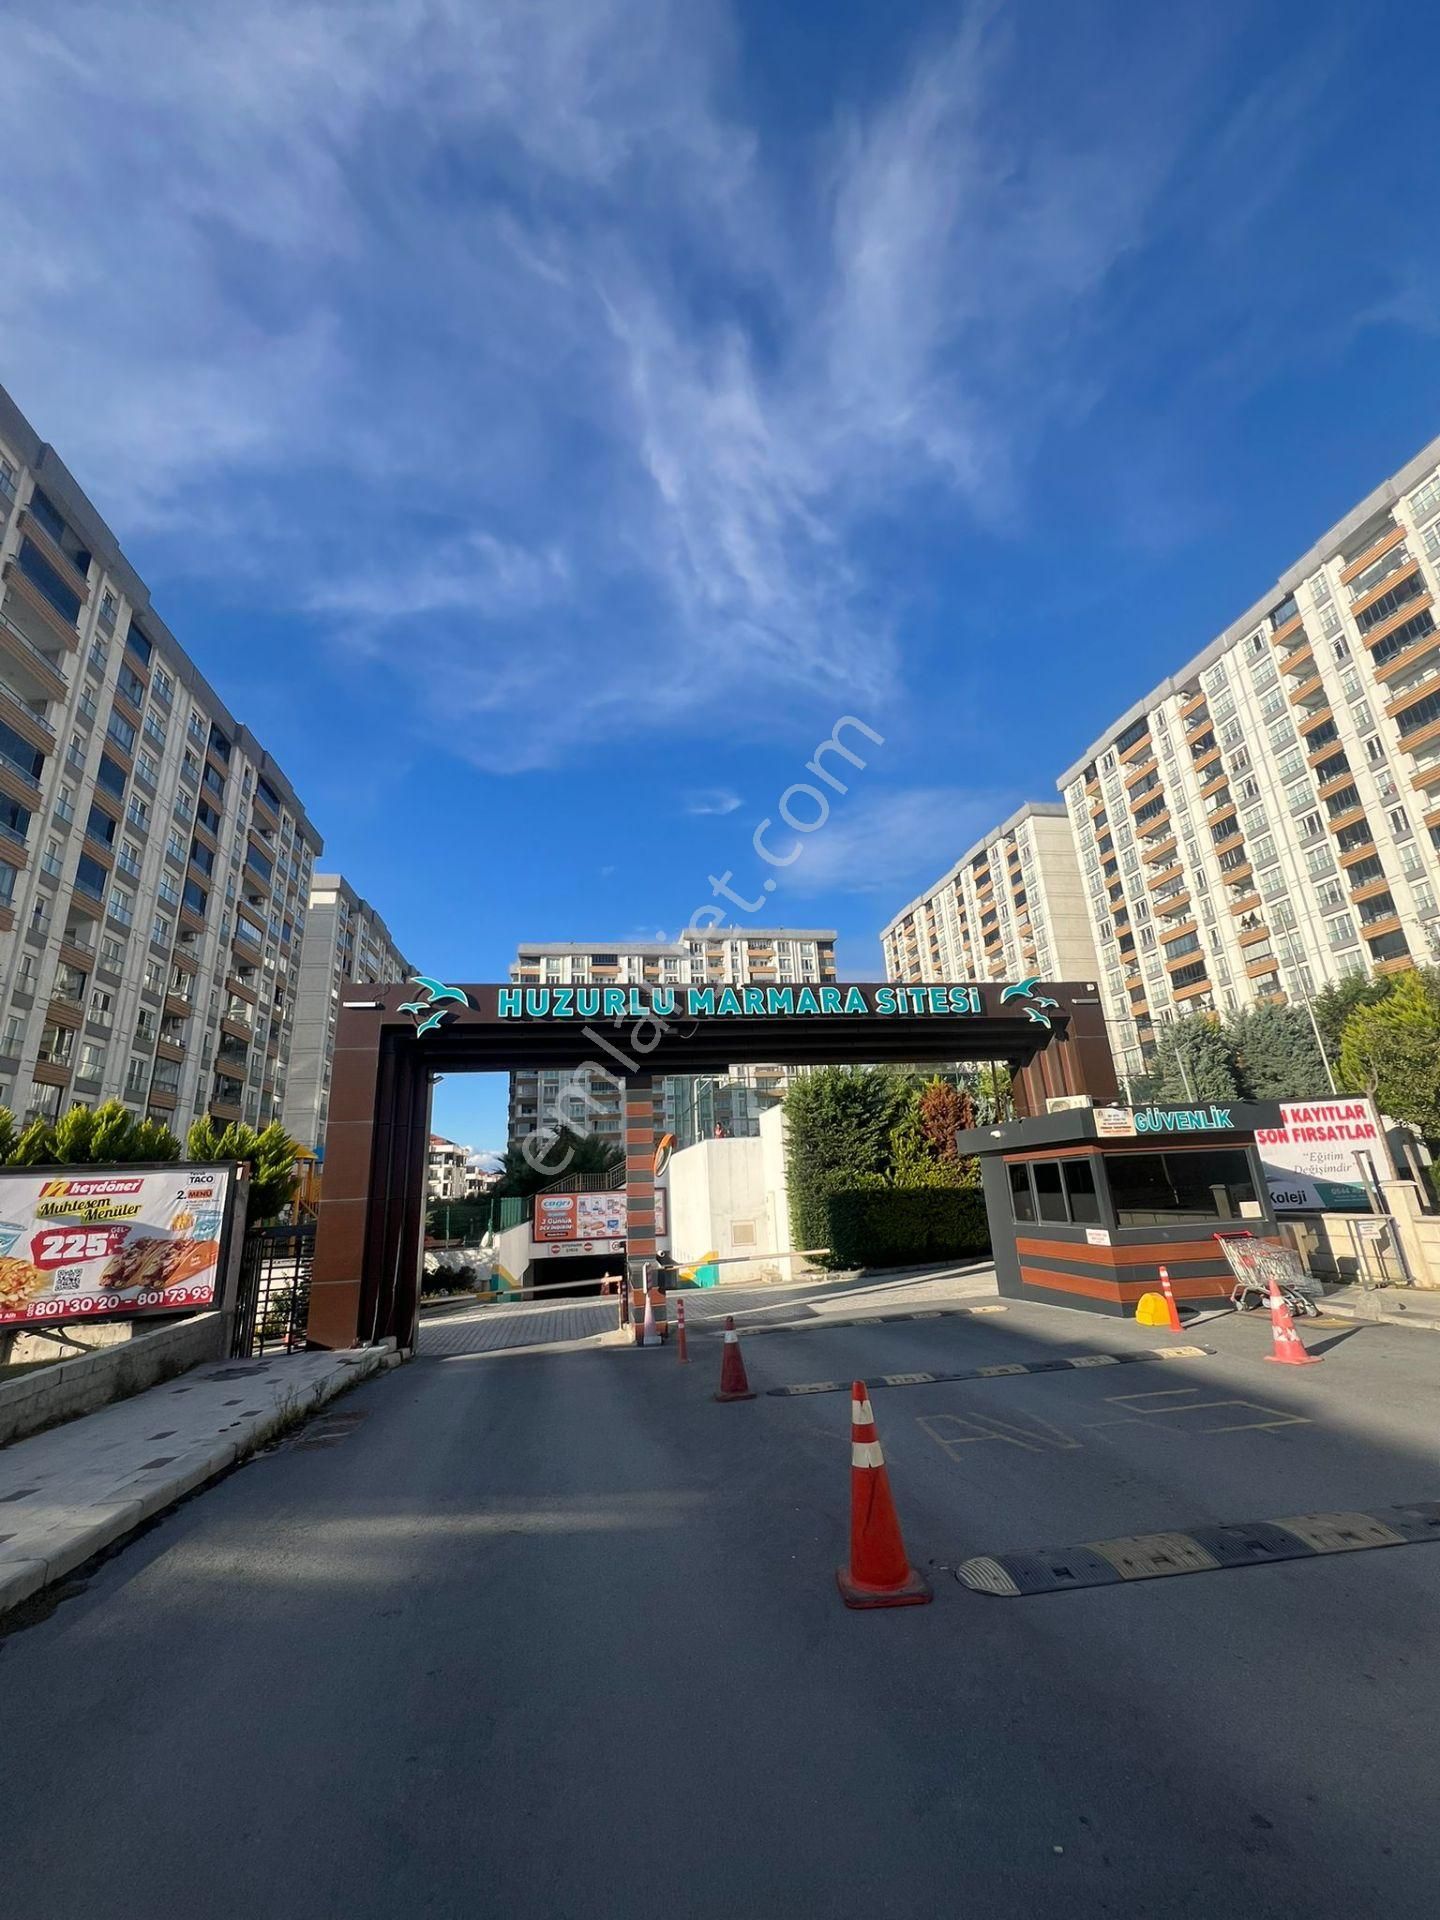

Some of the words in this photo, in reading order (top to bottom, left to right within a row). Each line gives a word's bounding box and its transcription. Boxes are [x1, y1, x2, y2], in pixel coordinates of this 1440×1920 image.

[497, 987, 675, 1018] HUZURLU
[687, 986, 869, 1016] MARMARA
[1133, 1105, 1235, 1132] GÜVENLİK
[1290, 1104, 1367, 1124] KAYITLAR
[1257, 1128, 1290, 1145] SON
[1291, 1123, 1377, 1143] FIRSATLAR
[69, 1180, 140, 1195] heydöner
[190, 1175, 214, 1183] TACO
[176, 1190, 187, 1200] 2.
[188, 1189, 213, 1199] MENÜ
[83, 1204, 142, 1221] Menüler
[34, 1300, 65, 1316] 801
[69, 1296, 93, 1312] 30
[97, 1295, 120, 1310] 20
[137, 1291, 164, 1306] 801
[168, 1288, 187, 1303] 73
[190, 1286, 211, 1300] 93
